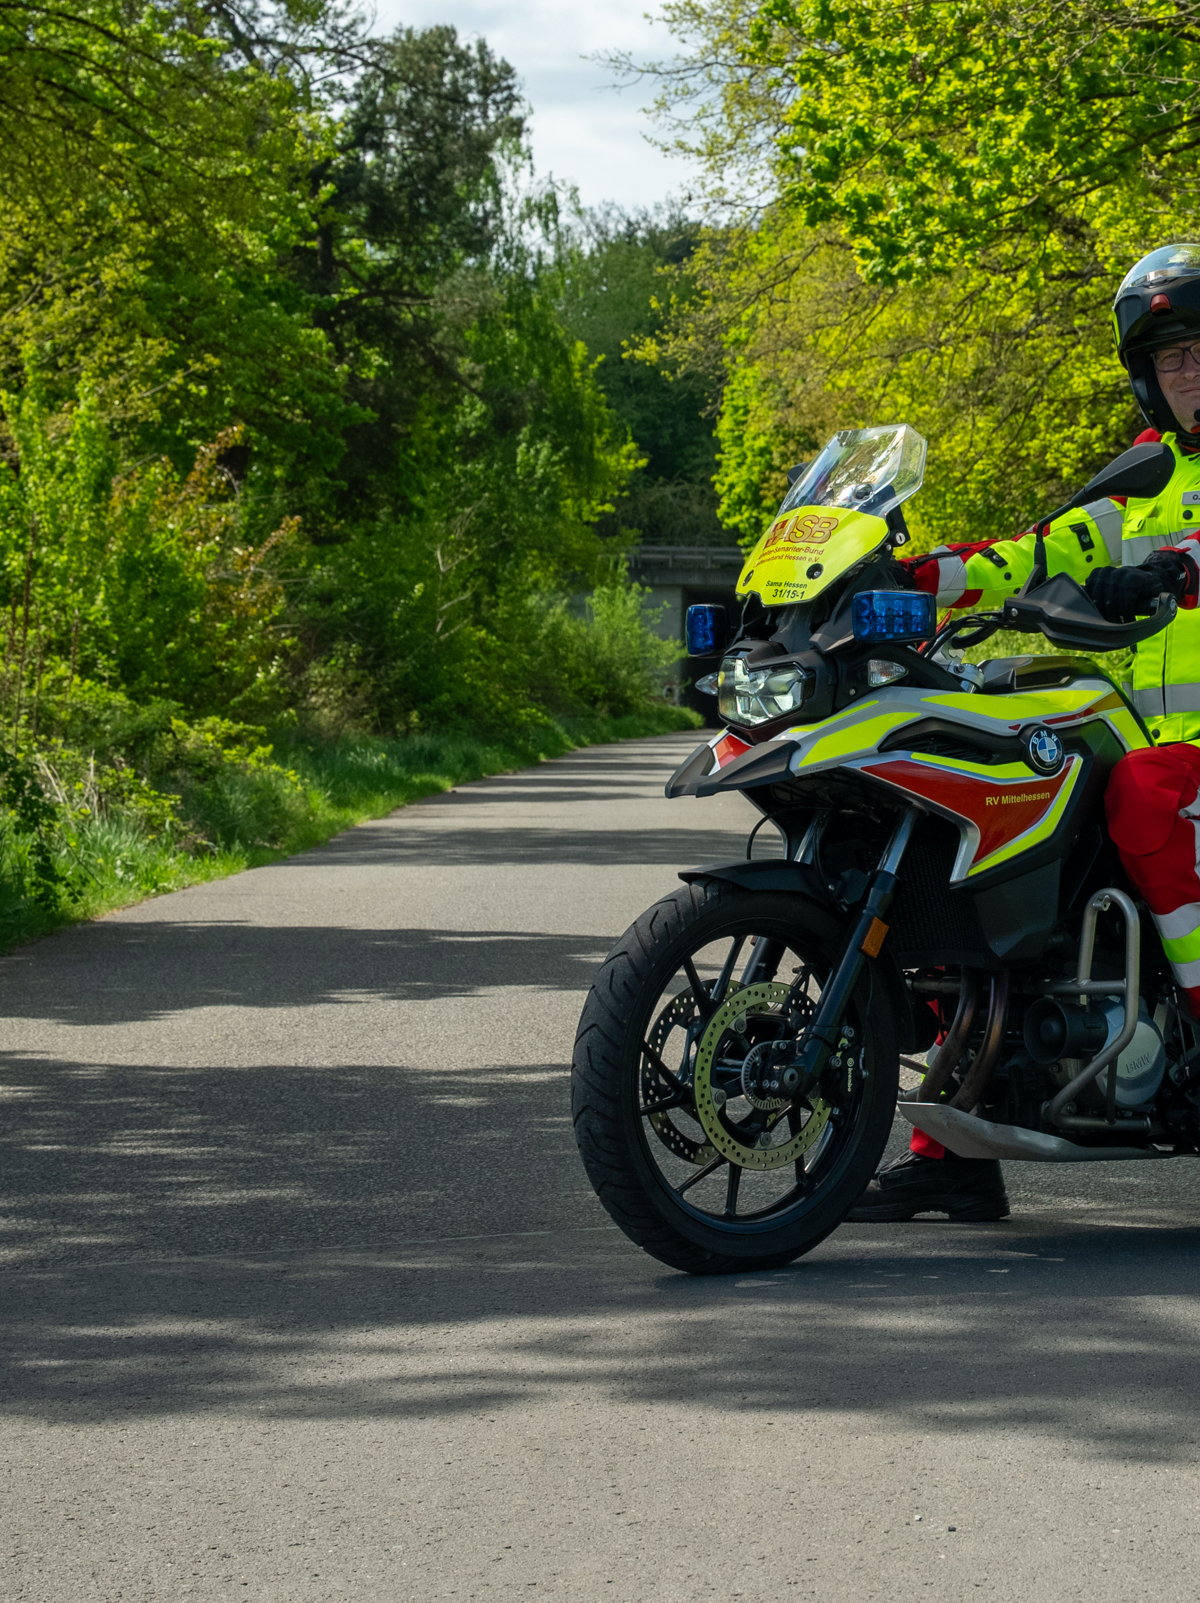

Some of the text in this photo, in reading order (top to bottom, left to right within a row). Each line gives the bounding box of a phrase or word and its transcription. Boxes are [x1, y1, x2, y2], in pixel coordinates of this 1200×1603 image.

[784, 554, 806, 562] Hessen
[772, 589, 805, 599] 31/15-1
[1032, 730, 1058, 745] BMW
[986, 792, 1050, 806] RV Mittelhessen
[1126, 1052, 1151, 1074] BMW
